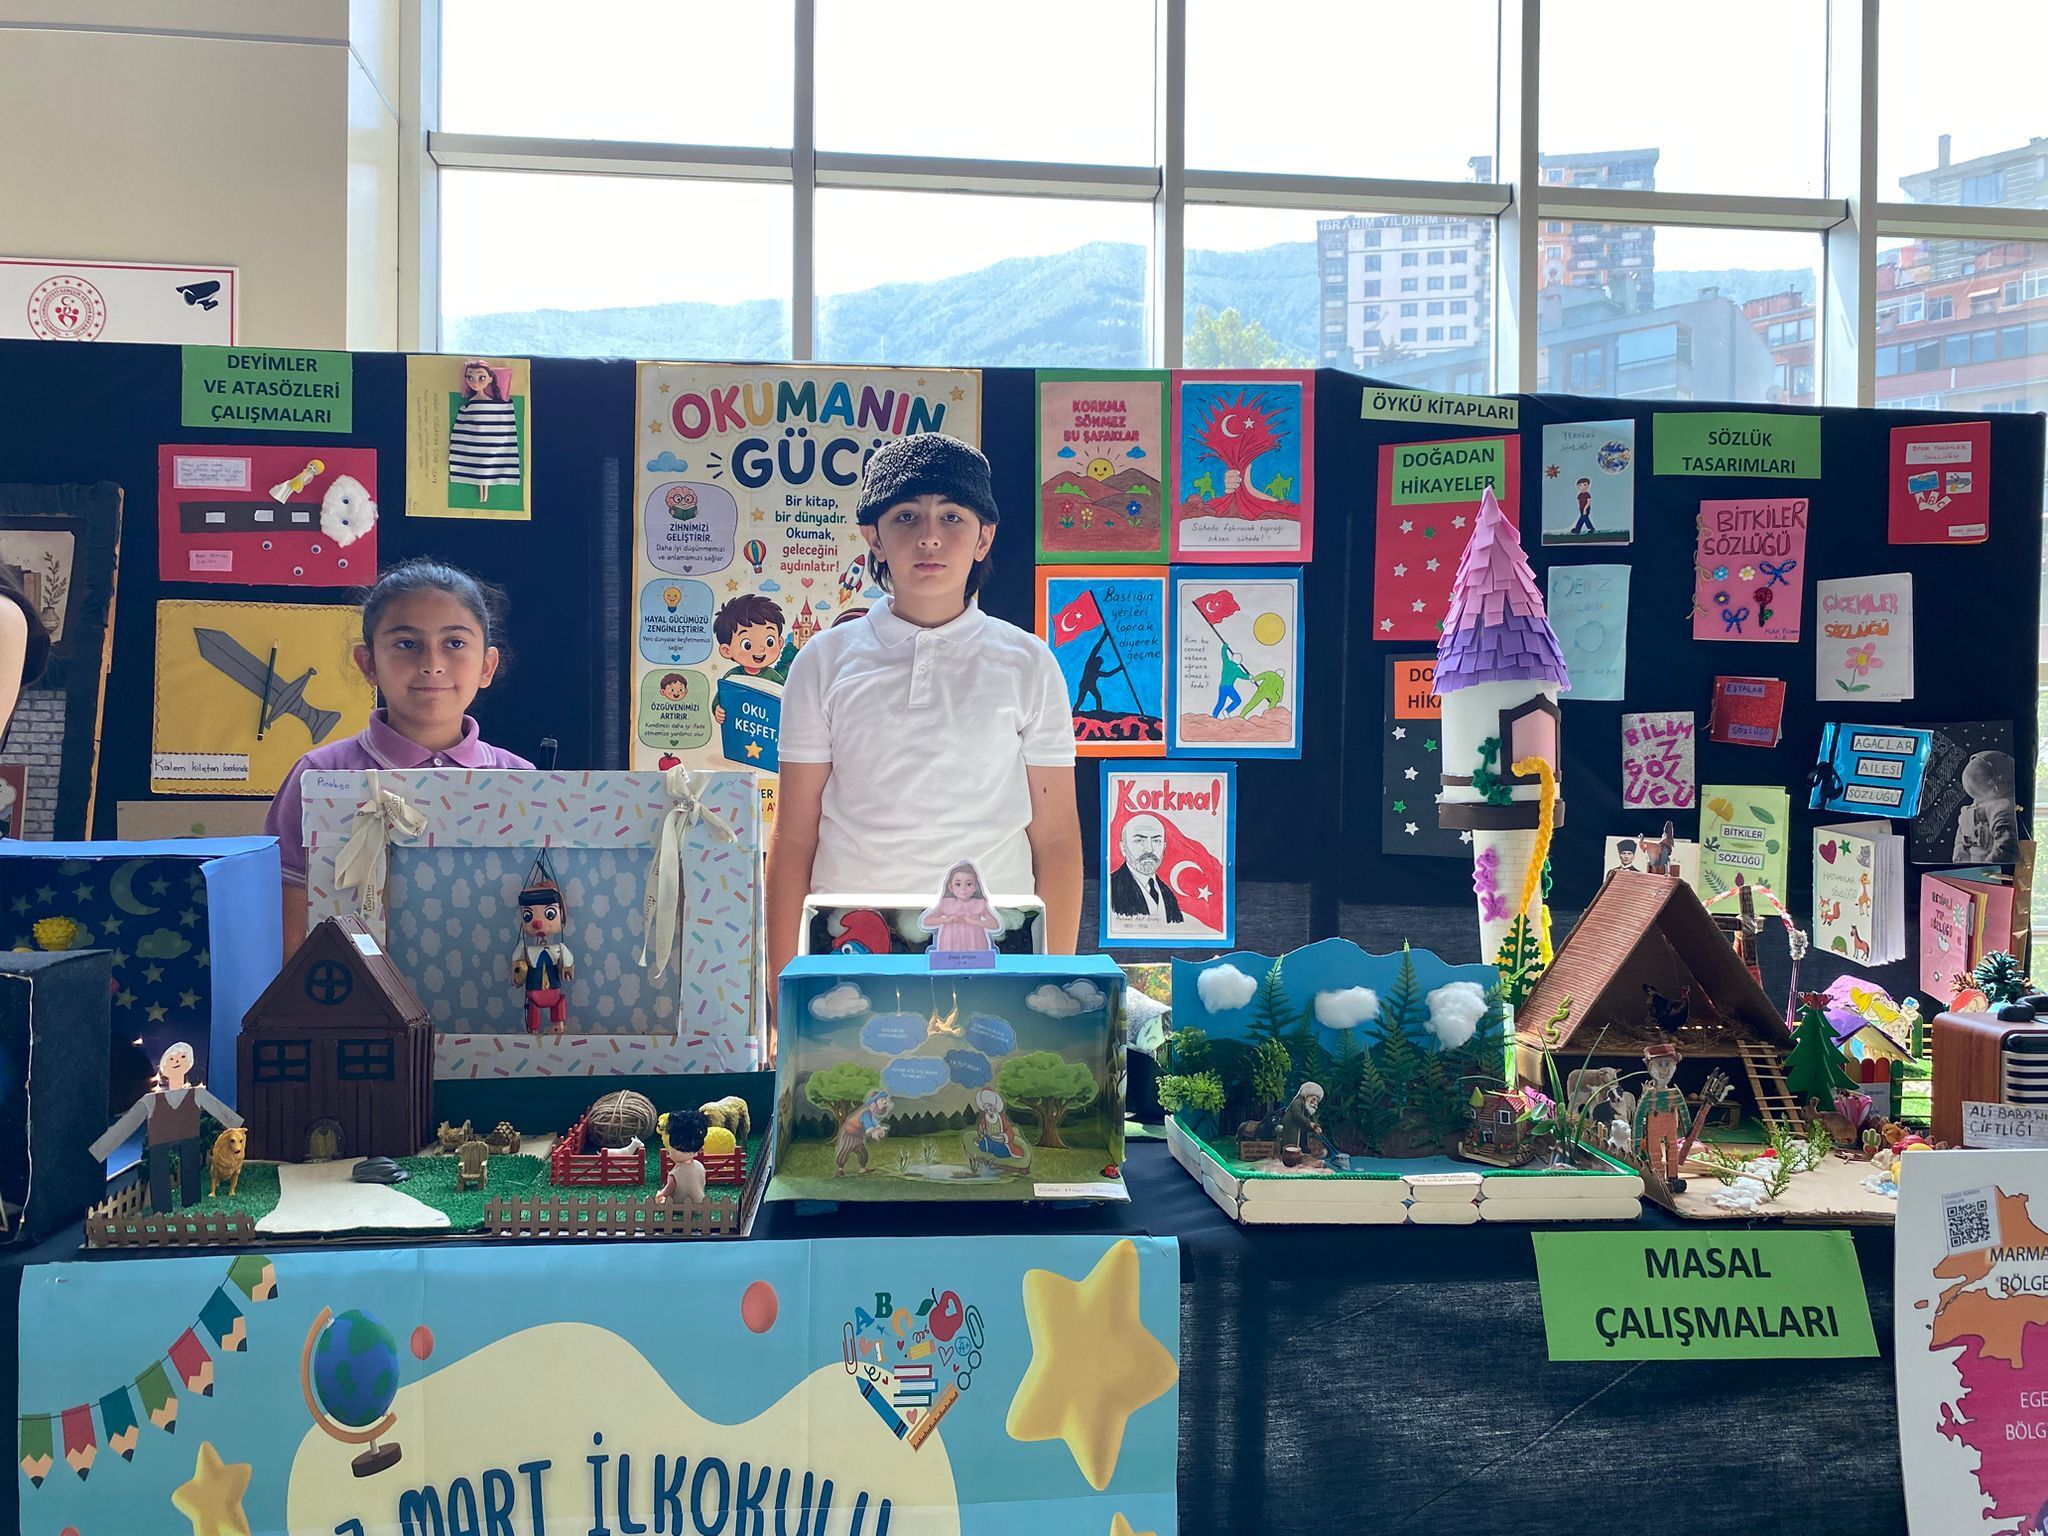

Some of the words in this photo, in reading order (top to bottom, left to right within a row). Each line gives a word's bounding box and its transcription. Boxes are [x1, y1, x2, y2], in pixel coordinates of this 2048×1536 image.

[227, 353, 318, 373] DEYİMLER
[203, 379, 227, 394] VE
[231, 380, 340, 398] ATASÖZLERİ
[211, 405, 331, 423] ÇALIŞMALARI
[671, 380, 947, 440] OKUMANIN
[1072, 400, 1127, 413] KORKMA
[1372, 395, 1422, 413] ÖYKÜ
[1427, 397, 1514, 420] KİTAPLARI
[1075, 413, 1127, 428] SÖNMEZ
[1063, 430, 1080, 442] BU
[1083, 430, 1140, 444] ŞAFAKLAR
[1708, 427, 1772, 448] SÖZLÜK
[1403, 447, 1495, 468] DOĞADAN
[1682, 456, 1796, 474] TASARIMLARI
[1401, 475, 1495, 495] HİKAYELER
[785, 494, 803, 507] Bir
[805, 495, 839, 510] kitap,
[775, 511, 792, 523] bir
[794, 511, 848, 526] dünyadır.
[1717, 500, 1806, 532] BİTKİLER
[670, 522, 709, 532] ZİHNİMİZİ
[786, 527, 835, 541] Okumak,
[782, 543, 838, 559] geleceğini
[1702, 530, 1791, 557] SÖZLÜĞÜ
[780, 560, 840, 574] aydınlatır!
[644, 615, 667, 623] HAYAL
[1111, 605, 1149, 623] yerleri
[1115, 620, 1153, 635] toprak
[742, 702, 769, 722] OKU,
[735, 717, 778, 743] KEŞFET,
[154, 758, 186, 772] Kalem
[1117, 779, 1222, 816] Korkma!
[1969, 1104, 1993, 1118] ALİ
[1644, 1247, 1772, 1278] MASAL
[1595, 1305, 1840, 1347] ÇALIŞMALARI
